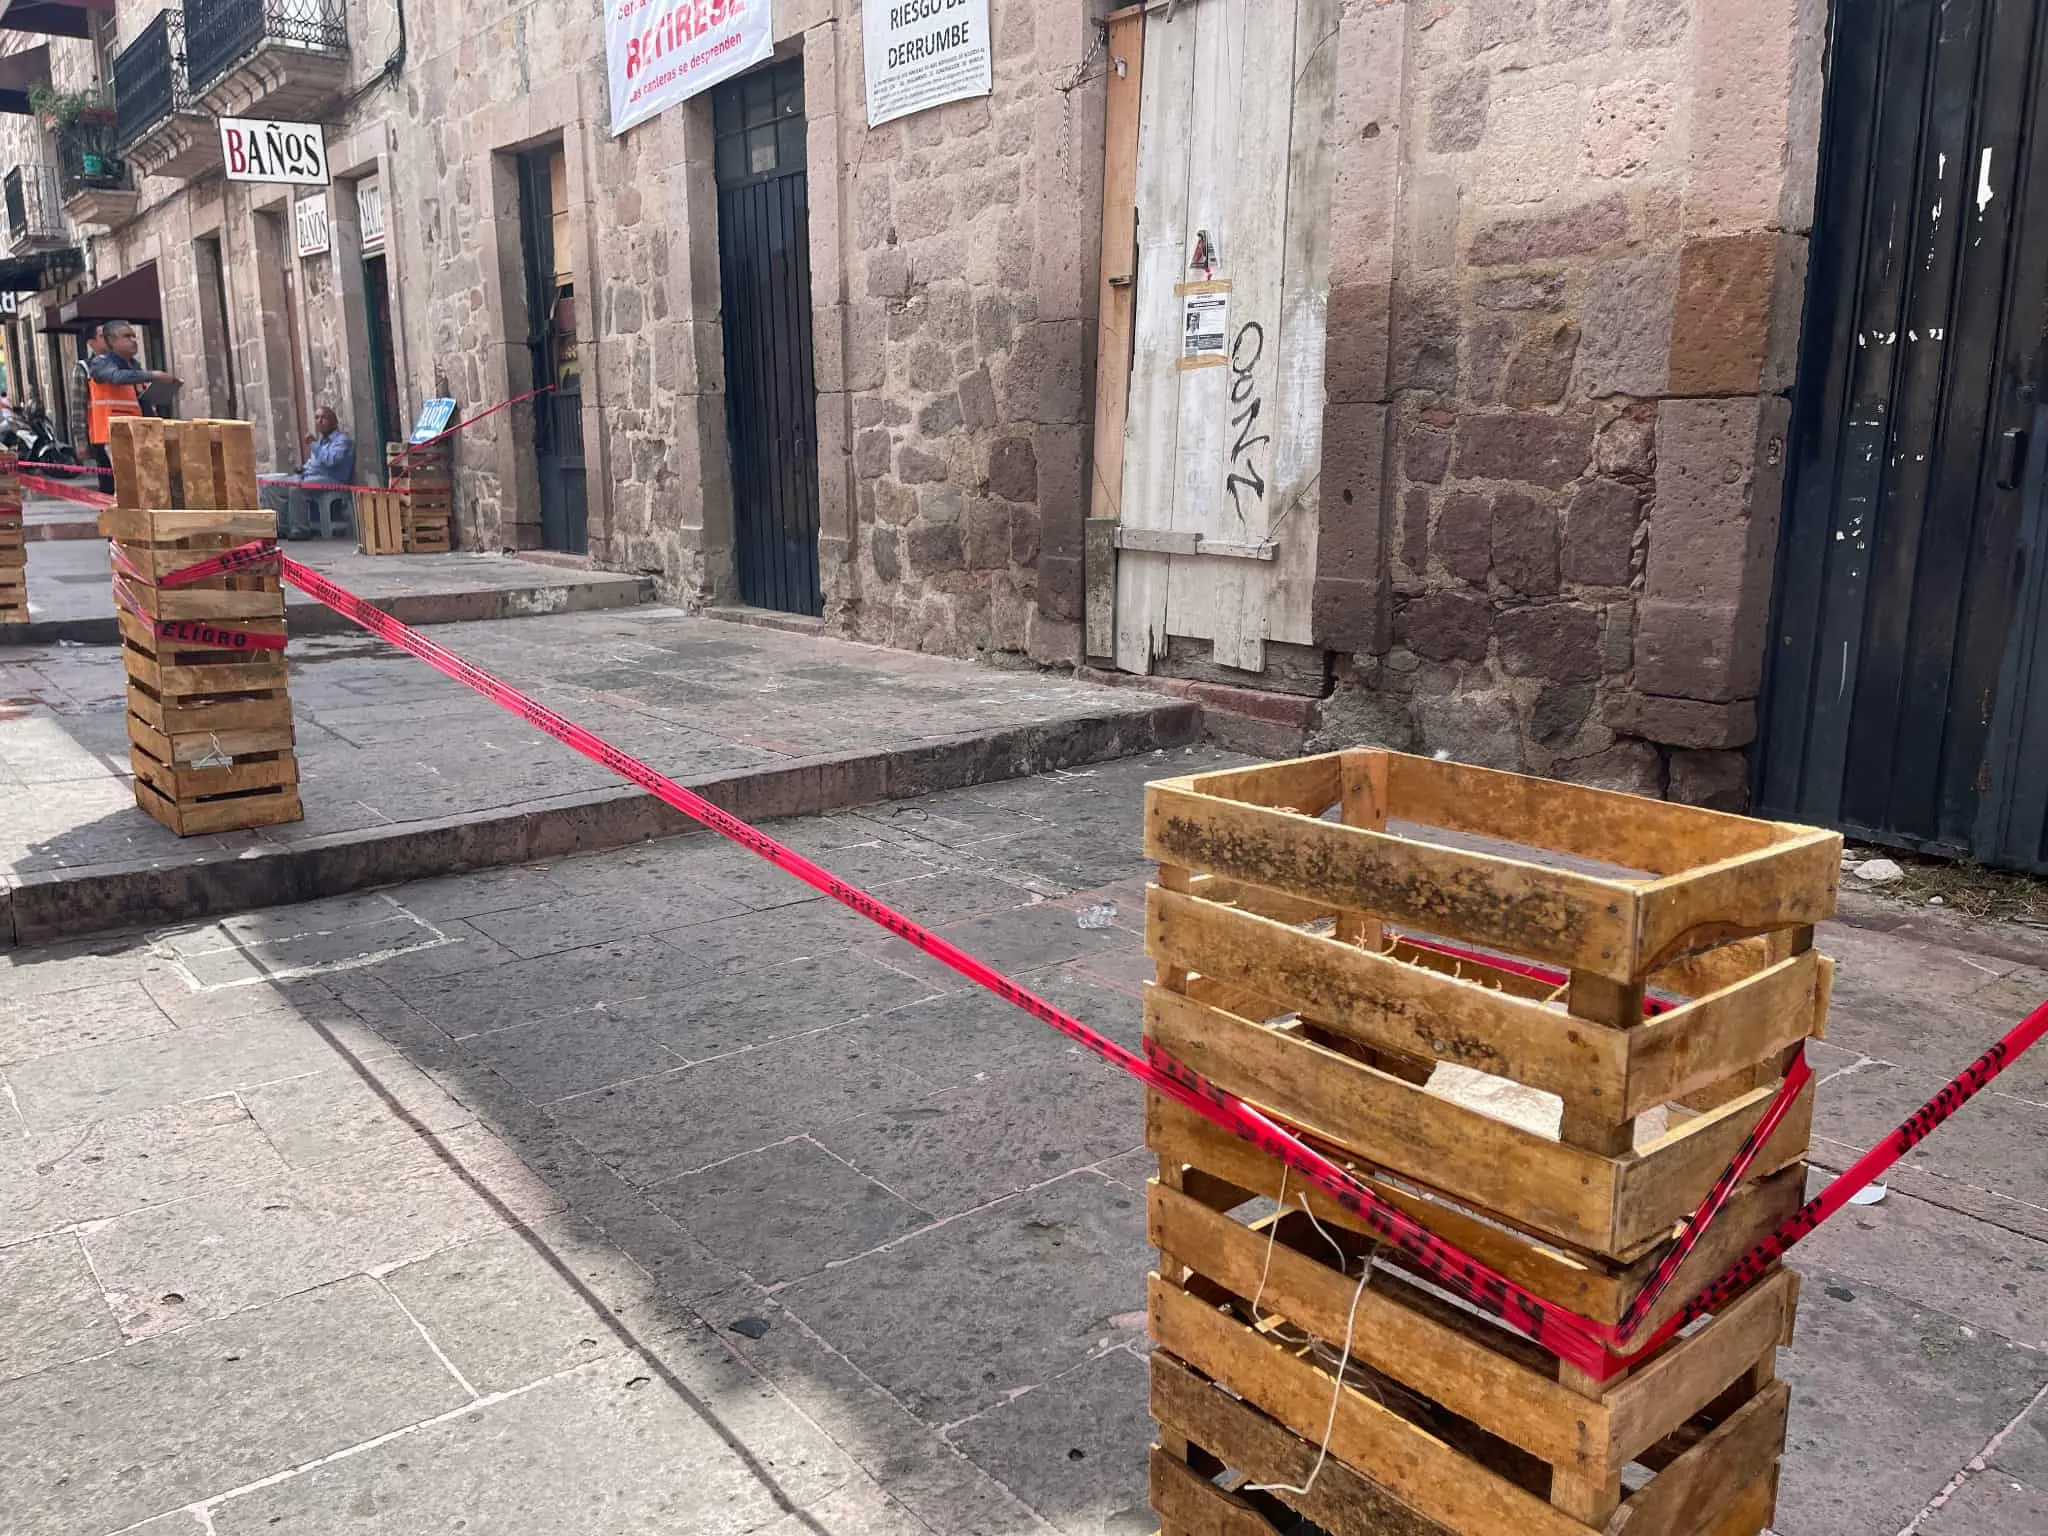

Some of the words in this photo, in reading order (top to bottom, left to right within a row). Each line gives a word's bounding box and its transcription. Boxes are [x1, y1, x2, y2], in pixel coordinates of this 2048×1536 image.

[890, 0, 941, 31] RIESGO
[679, 62, 689, 76] se
[690, 32, 743, 69] desprenden
[888, 21, 969, 69] DERRUMBE
[226, 123, 321, 176] BAÑOS
[161, 622, 247, 647] ELIGRO
